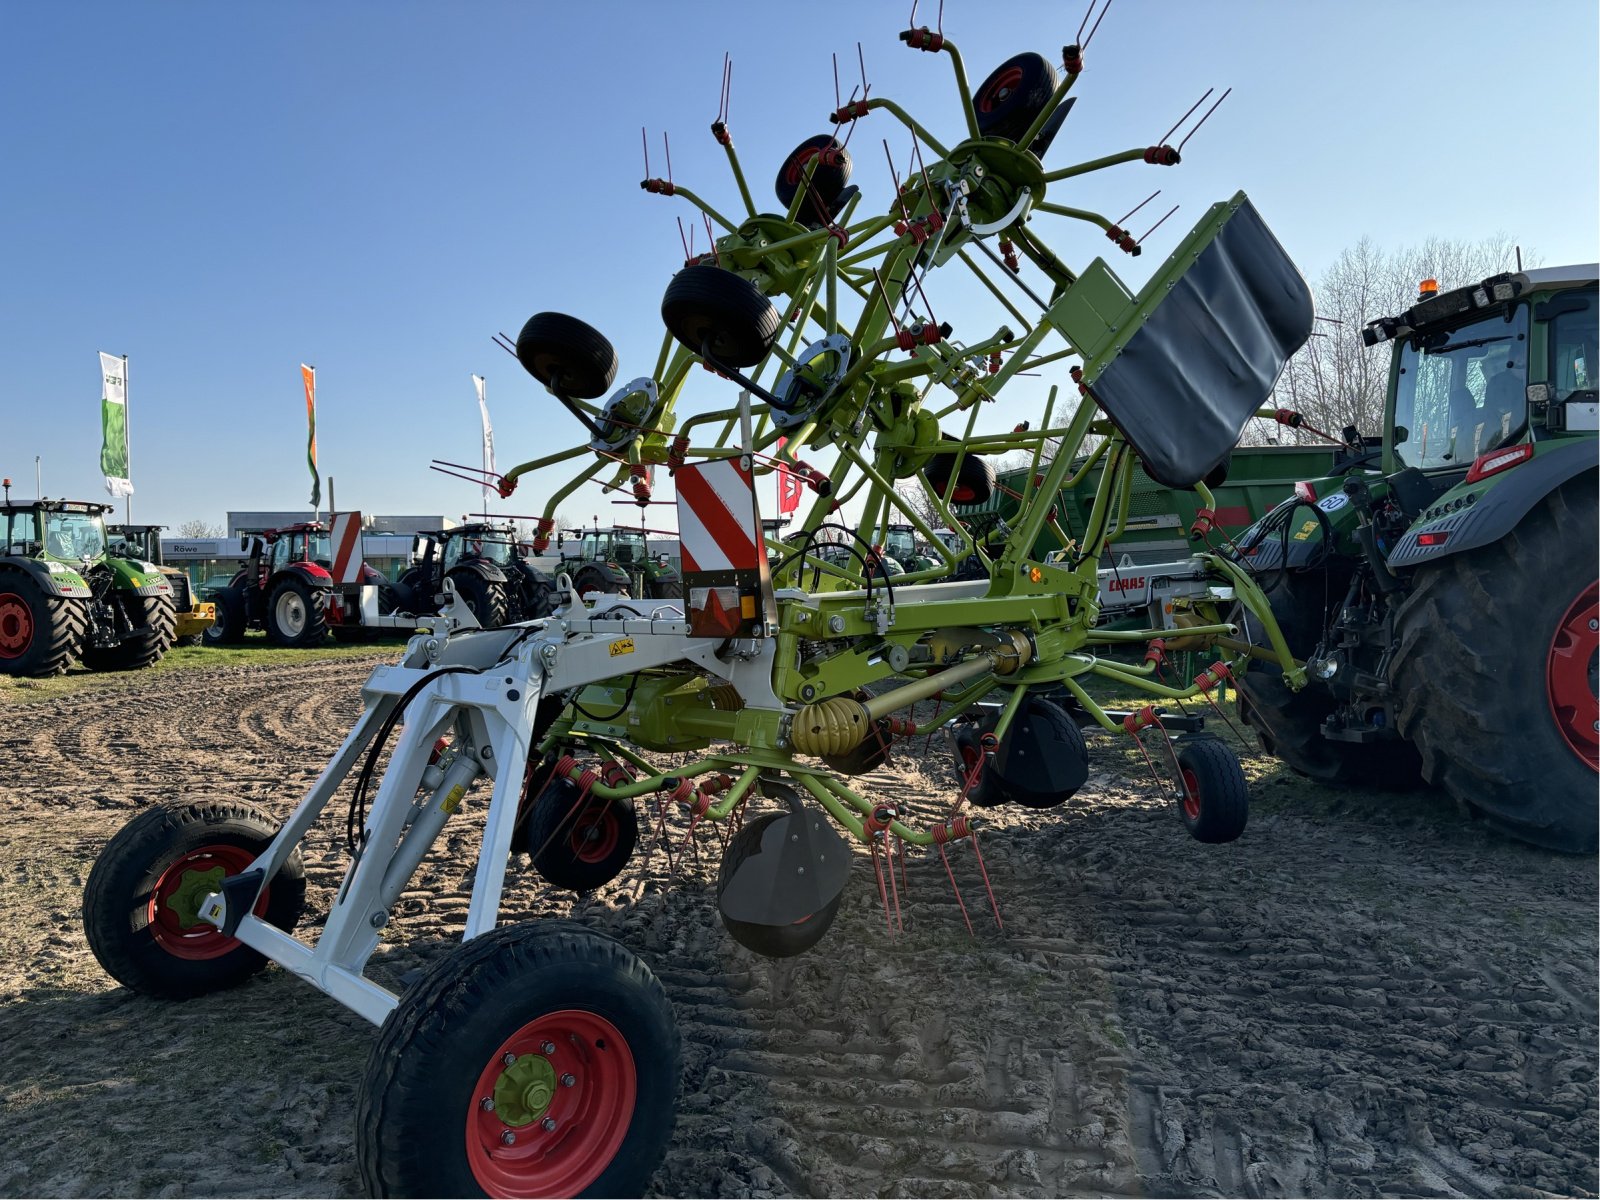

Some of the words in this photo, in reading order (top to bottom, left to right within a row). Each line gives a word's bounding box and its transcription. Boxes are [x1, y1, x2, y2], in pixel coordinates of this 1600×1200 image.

[1320, 496, 1345, 510] 60
[174, 545, 198, 553] Röwe
[1109, 577, 1145, 592] CLAAS
